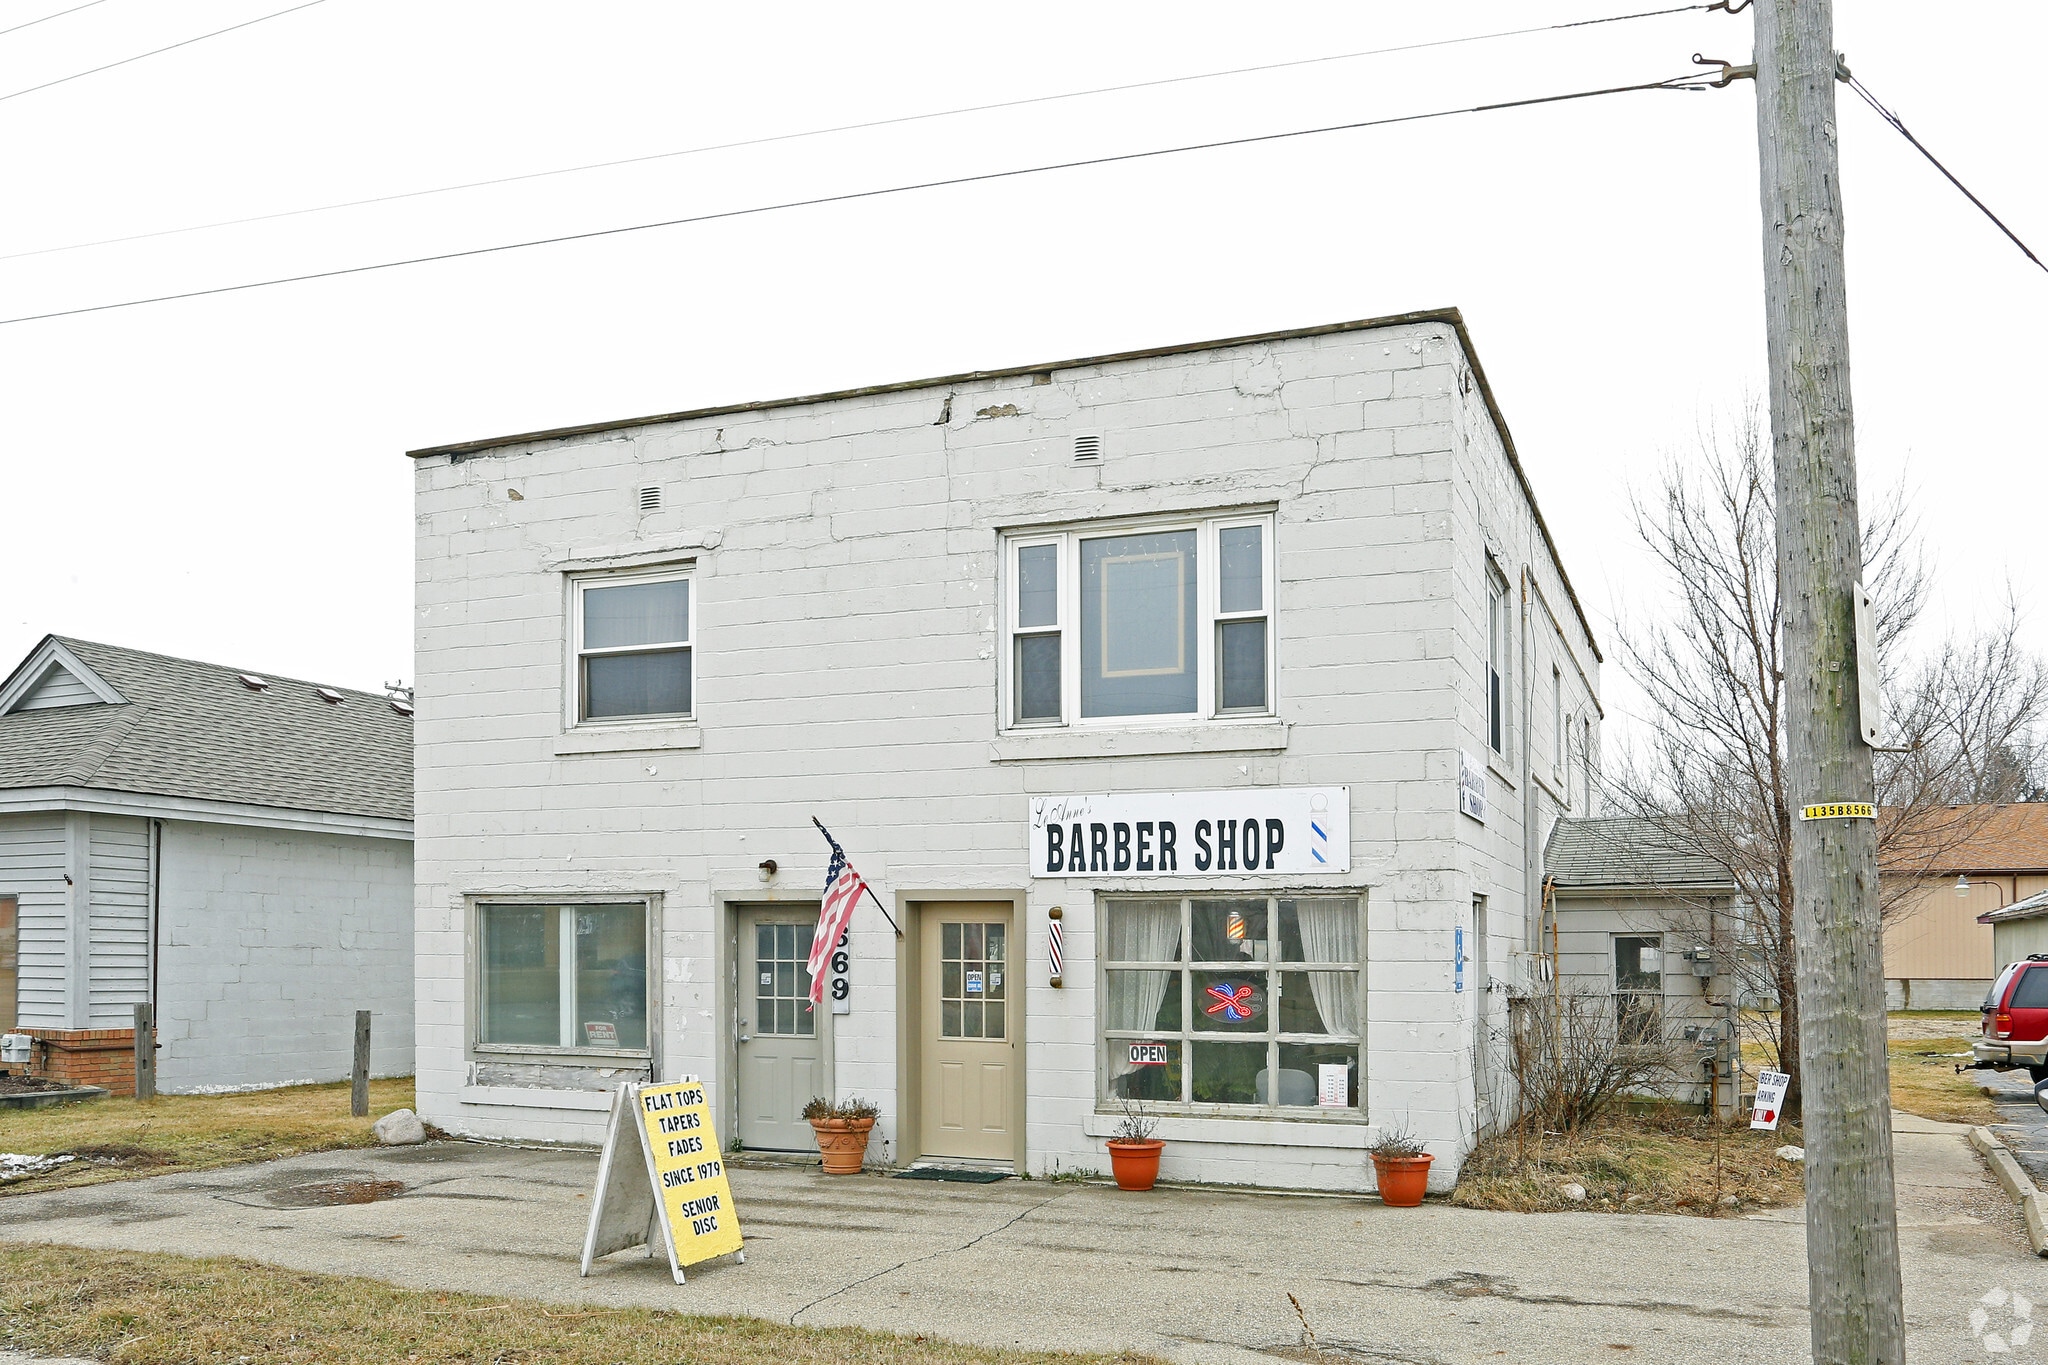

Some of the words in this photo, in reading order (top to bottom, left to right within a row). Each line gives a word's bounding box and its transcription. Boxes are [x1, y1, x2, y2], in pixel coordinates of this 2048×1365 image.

[1805, 804, 1872, 818] L135B8566
[1046, 821, 1178, 872] BARBER
[1194, 818, 1285, 870] SHOP
[967, 973, 982, 981] OPEN
[1130, 1046, 1166, 1062] OPEN
[1772, 1074, 1788, 1087] SHOP
[644, 1093, 674, 1111] FLAT
[675, 1089, 704, 1106] TOPS
[659, 1113, 701, 1133] TAPERS
[668, 1136, 703, 1157] FADES
[663, 1167, 695, 1188] SINCE
[697, 1161, 720, 1180] 1979
[682, 1195, 720, 1218] SENIOR
[693, 1216, 718, 1236] DISC
